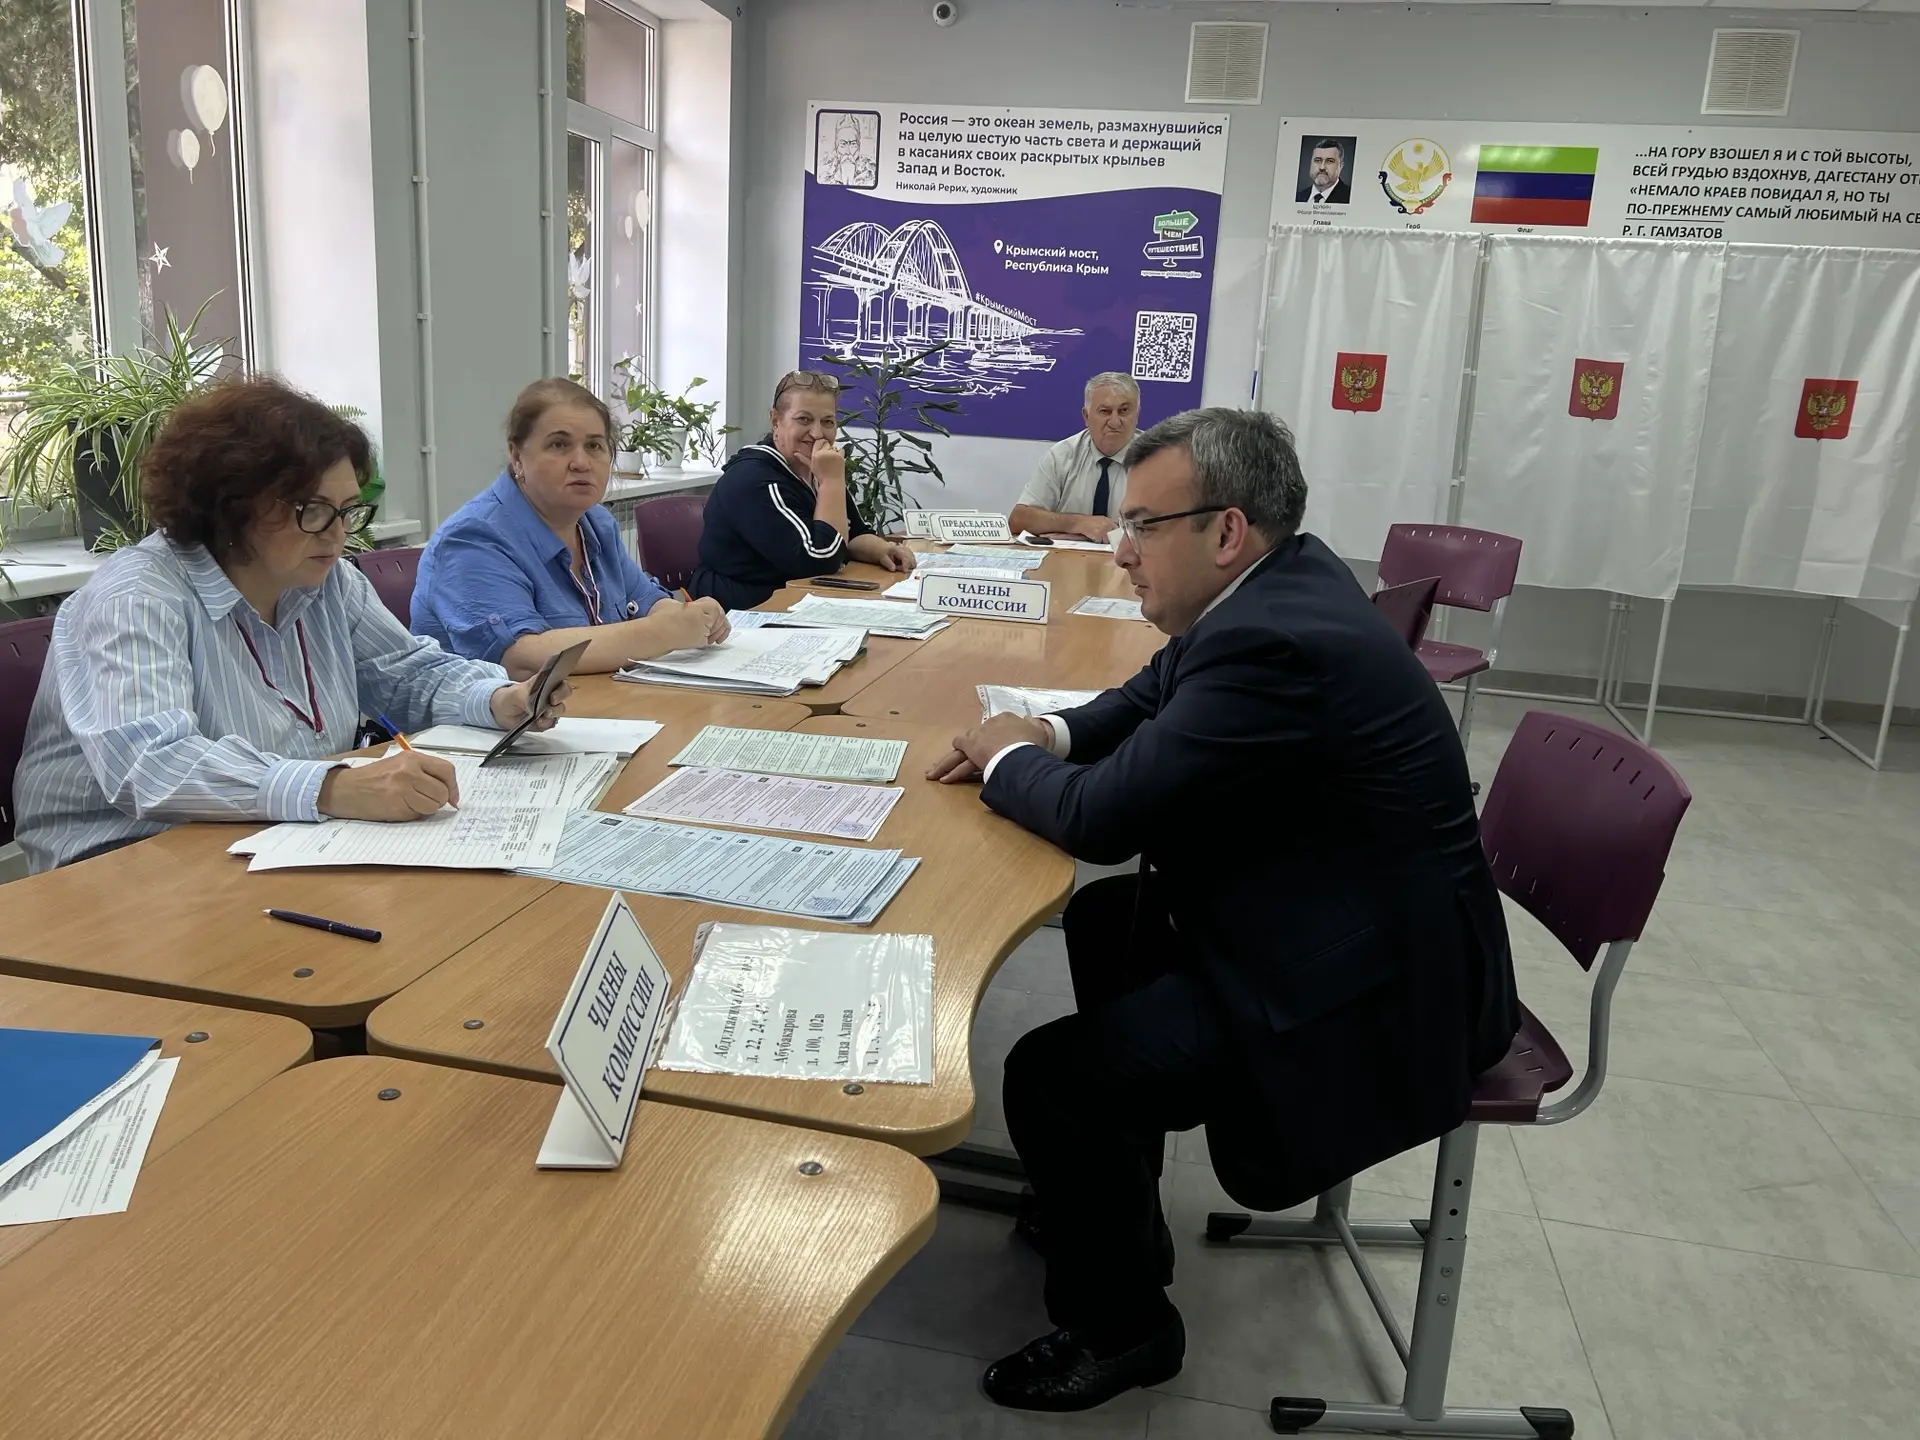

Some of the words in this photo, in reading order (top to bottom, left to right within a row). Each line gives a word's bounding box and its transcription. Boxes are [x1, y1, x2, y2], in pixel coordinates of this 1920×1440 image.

[899, 112, 948, 126] Россия
[968, 117, 990, 127] это
[994, 118, 1035, 129] океан
[1038, 119, 1093, 133] земель,
[1097, 121, 1223, 135] размахнувшийся
[898, 131, 915, 141] на
[918, 131, 963, 145] целую
[966, 133, 1021, 147] шестую
[1024, 135, 1063, 146] часть
[1066, 137, 1105, 148] света
[1109, 138, 1118, 148] и
[1122, 139, 1201, 152] держащий
[898, 148, 905, 157] в
[909, 148, 973, 160] касаниях
[976, 150, 1017, 161] своих
[1020, 152, 1099, 166] раскрытых
[1103, 155, 1165, 168] крыльев
[1671, 147, 1706, 159] ГОРУ
[1709, 148, 1769, 160] ВЗОШЕЛ
[1773, 149, 1782, 160] Я
[1786, 150, 1797, 161] И
[1800, 150, 1810, 162] С
[1813, 149, 1842, 162] ТОЙ
[1846, 152, 1912, 167] ВЫСОТЫ,
[897, 161, 938, 177] Запад
[941, 165, 950, 175] и
[953, 164, 1005, 178] Восток.
[1632, 163, 1668, 177] ВСЕЙ
[1671, 166, 1729, 181] ГРУДЬЮ
[1732, 168, 1811, 183] ВЗДОХНУВ,
[1813, 170, 1897, 184] ДАГЕСТАНУ
[896, 181, 936, 191] Николай
[938, 183, 969, 194] Рерих,
[970, 185, 1018, 195] художник
[1630, 184, 1700, 197] «НЕМАЛО
[1703, 186, 1747, 198] КРАЕВ
[1750, 187, 1822, 202] ПОВИДАЛ
[1826, 190, 1839, 203] Я,
[1843, 191, 1865, 202] НО
[1869, 191, 1890, 203] ТЫ
[1626, 203, 1733, 217] ПО-ПРЕЖНЕМУ
[1736, 205, 1791, 219] САМЫЙ
[1794, 208, 1878, 222] ЛЮБИМЫЙ
[1882, 211, 1901, 223] НА
[1158, 217, 1189, 227] БОЛЬШЕ
[1163, 230, 1182, 238] ЧЕМ
[1516, 227, 1534, 235] Флаг
[1622, 225, 1633, 236] Р.
[1637, 225, 1646, 237] Г.
[1650, 226, 1723, 239] ГАМЗАТОВ
[1005, 244, 1066, 257] Крымский
[1069, 249, 1099, 261] мост,
[1147, 243, 1199, 253] ПУТЕШЕСТВИЕ
[1005, 260, 1073, 273] Республика
[1076, 263, 1109, 275] Крым
[941, 519, 1005, 529] ПРЕДСЕДАТЕЛЬ
[952, 529, 1000, 537] КОМИССИИ
[957, 583, 1011, 597] ЧЛЕНЫ
[937, 596, 1027, 613] КОМИССИИ
[587, 950, 628, 1032] ЧЛЕНЫ
[808, 1013, 825, 1032] 102в
[837, 1009, 853, 1039] Алиева
[602, 964, 656, 1103] КОМИССИИ
[773, 1009, 799, 1064] Абубакарова
[745, 1038, 763, 1050] 22,
[805, 1036, 822, 1053] 100,
[833, 1041, 850, 1066] Азиза
